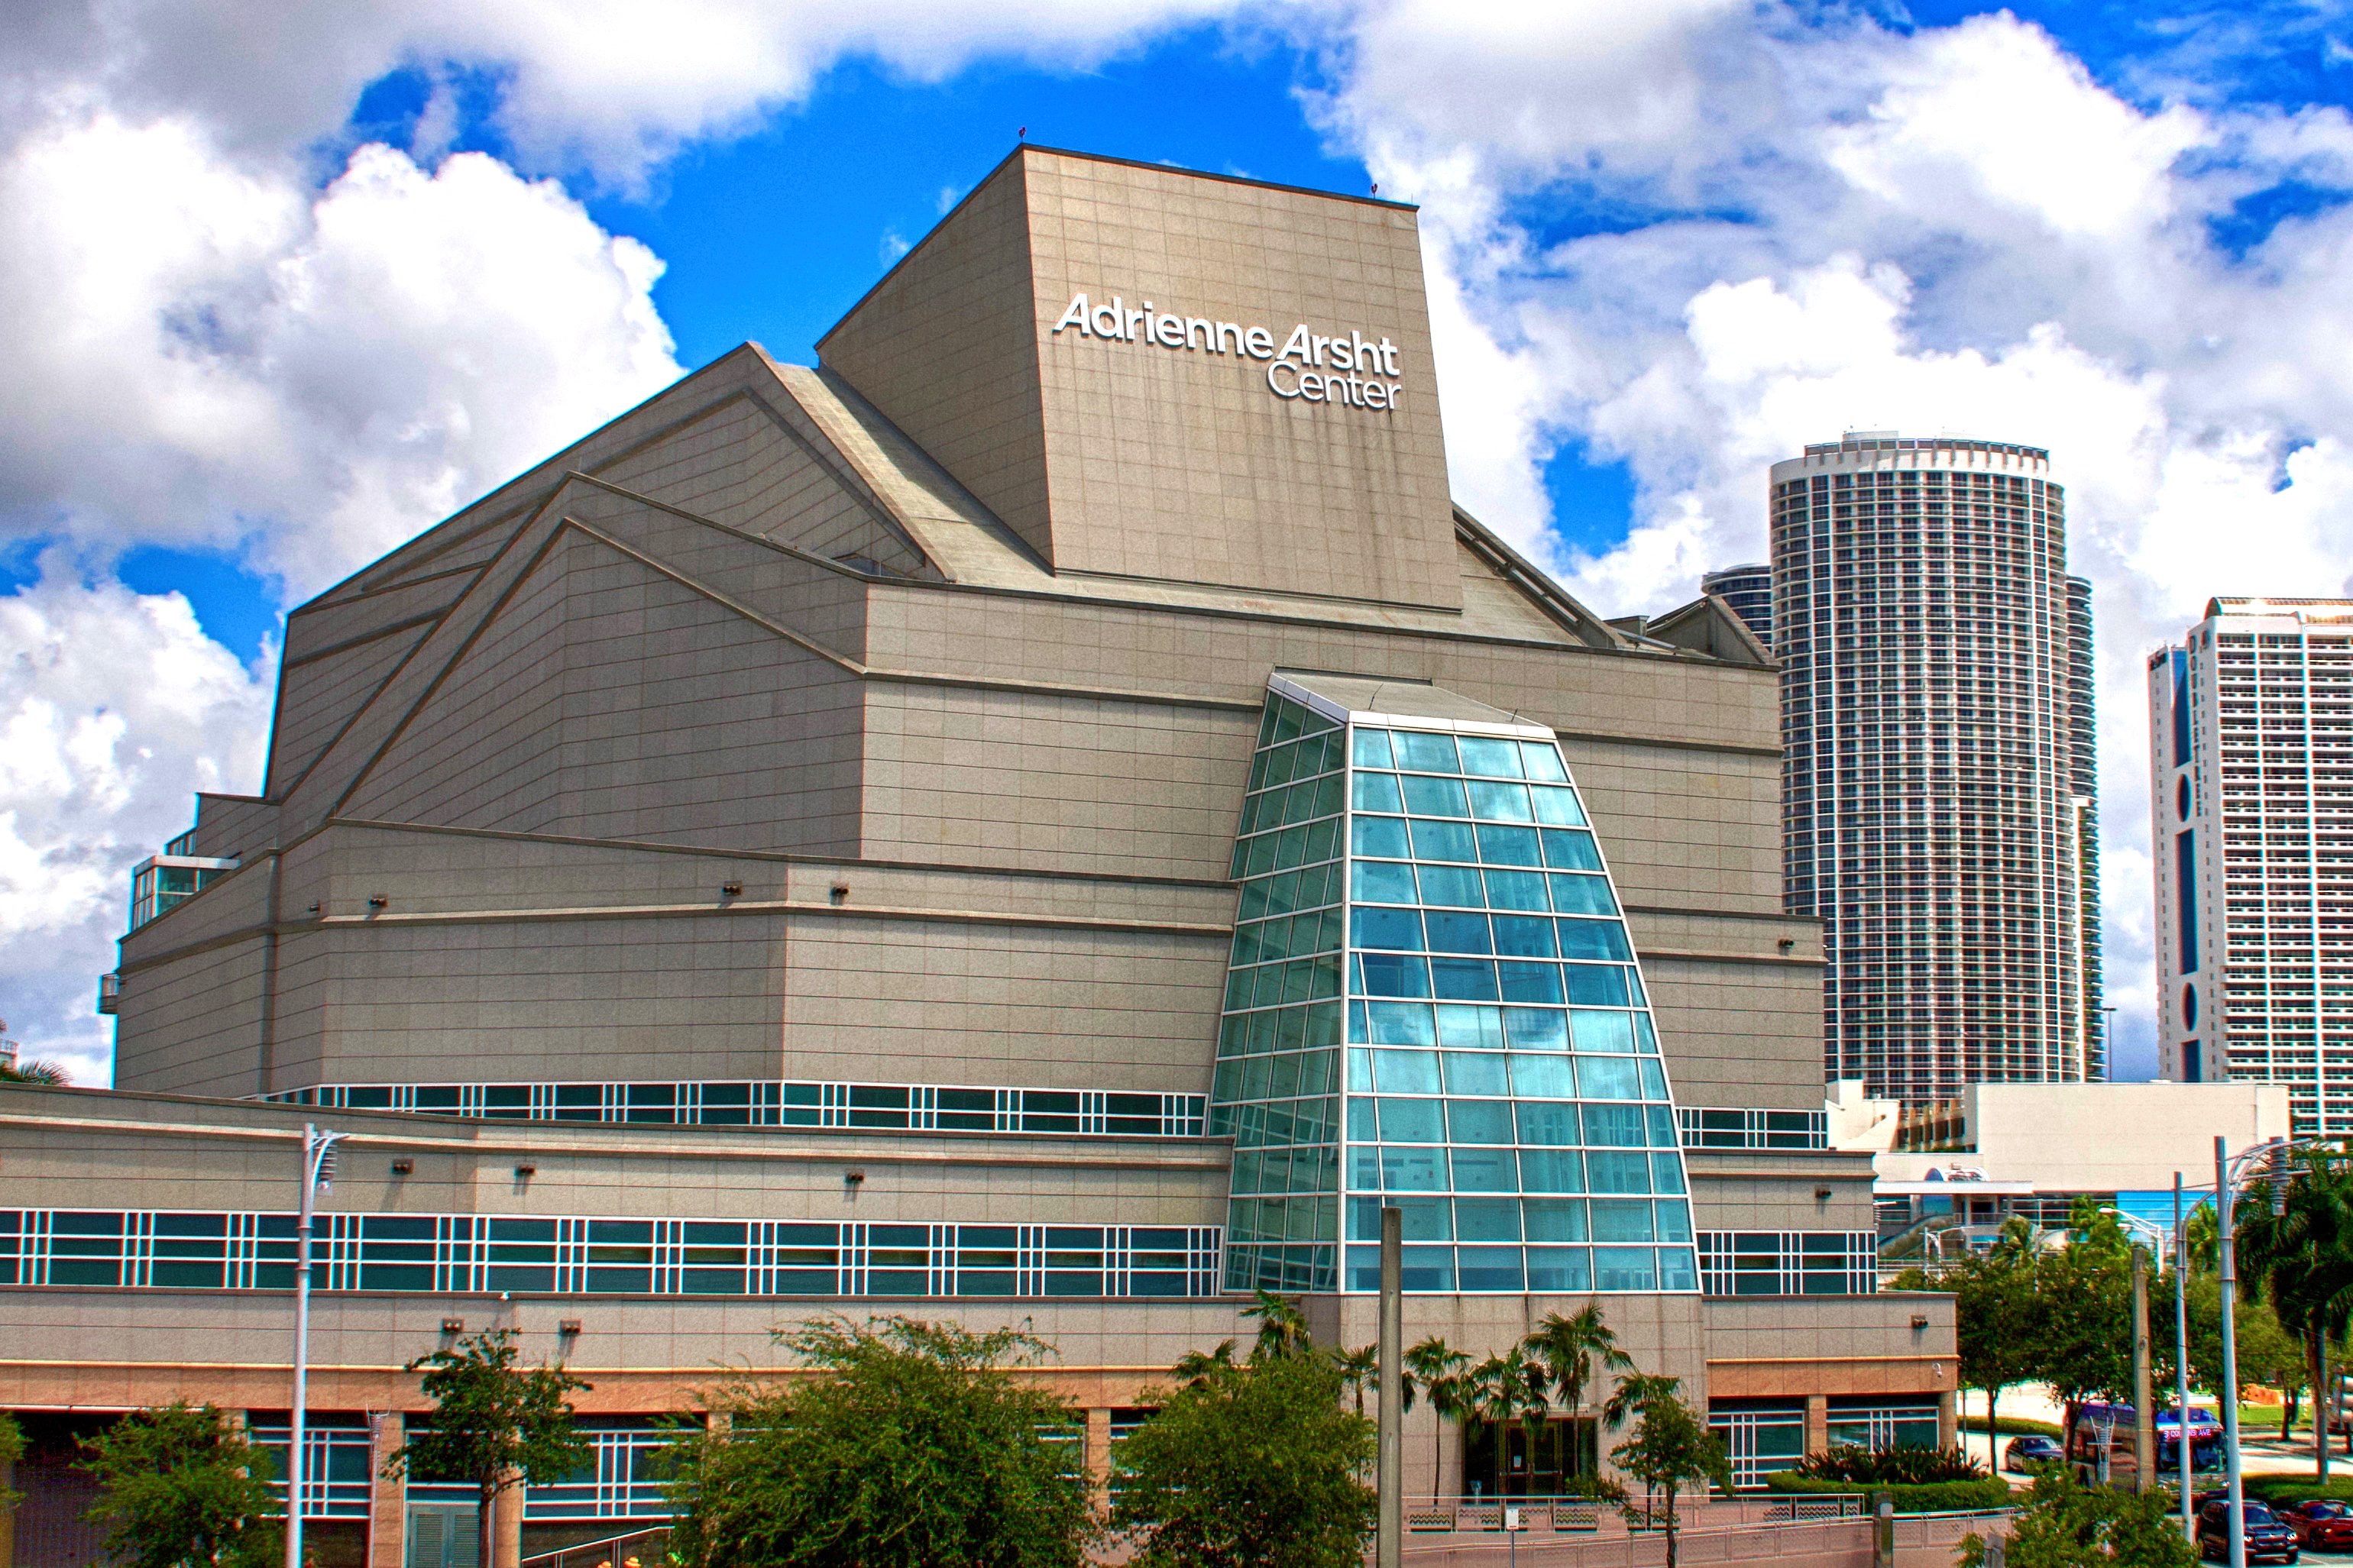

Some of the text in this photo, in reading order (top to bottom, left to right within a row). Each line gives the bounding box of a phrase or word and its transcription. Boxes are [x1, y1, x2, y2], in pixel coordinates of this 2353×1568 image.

[1052, 293, 1401, 377] Adrienne Arsht
[1267, 360, 1402, 409] Center
[2170, 1429, 2196, 1437] CONS
